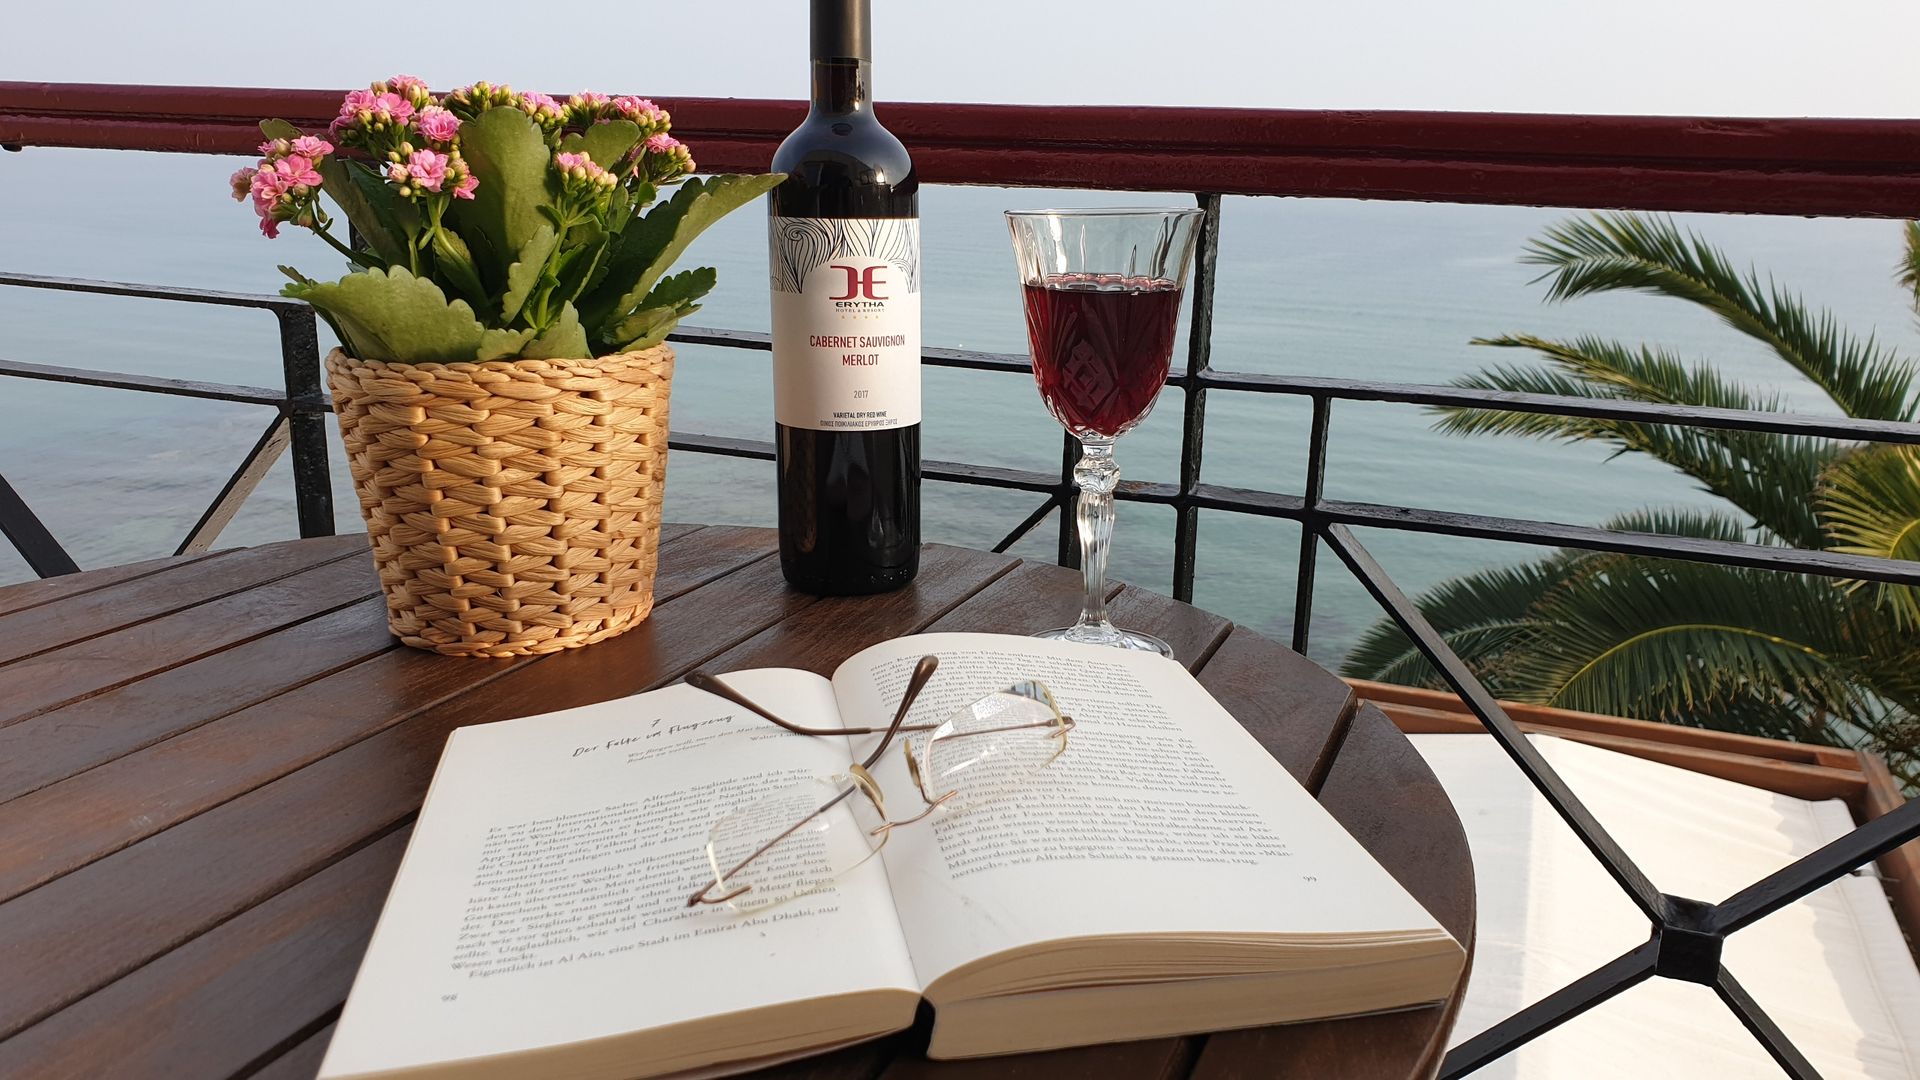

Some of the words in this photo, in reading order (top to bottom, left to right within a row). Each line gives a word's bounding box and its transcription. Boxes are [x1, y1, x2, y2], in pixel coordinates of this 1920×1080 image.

[810, 334, 858, 348] CABERNET
[859, 334, 905, 349] SAUVIGNON
[842, 354, 879, 366] MERLOT
[853, 390, 868, 399] 2017
[572, 745, 599, 757] Der
[646, 730, 662, 739] im
[670, 714, 737, 735] Flugzeug
[690, 777, 737, 791] Sieglinde
[643, 788, 715, 809] Falkenfestival
[719, 782, 758, 792] fliegen,
[719, 786, 769, 799] Nachdem
[1043, 792, 1091, 800] TV-Leute
[1095, 793, 1120, 802] mich
[714, 794, 756, 808] möglich
[957, 803, 1011, 820] arabischen
[1016, 800, 1091, 809] Kaschmirtuch
[669, 811, 711, 825] bestand
[935, 820, 972, 835] Falken
[1024, 808, 1053, 816] Faust
[1058, 808, 1105, 816] entdeckt
[958, 823, 1000, 838] wollten
[1003, 819, 1044, 828] wissen,
[1048, 816, 1079, 824] wieso
[940, 836, 971, 852] bisch
[1045, 824, 1119, 833] Krankenhaus
[1069, 833, 1115, 841] sichtlich
[948, 845, 1041, 870] Männerdomäne
[1060, 842, 1114, 852] begegnen
[1036, 851, 1086, 862] Alfredos
[1089, 851, 1132, 860] Scheich
[759, 882, 791, 892] Meter
[642, 909, 703, 926] Charakter
[638, 935, 668, 947] Stadt
[694, 922, 736, 936] Emirat
[771, 908, 814, 921] Dhabi,
